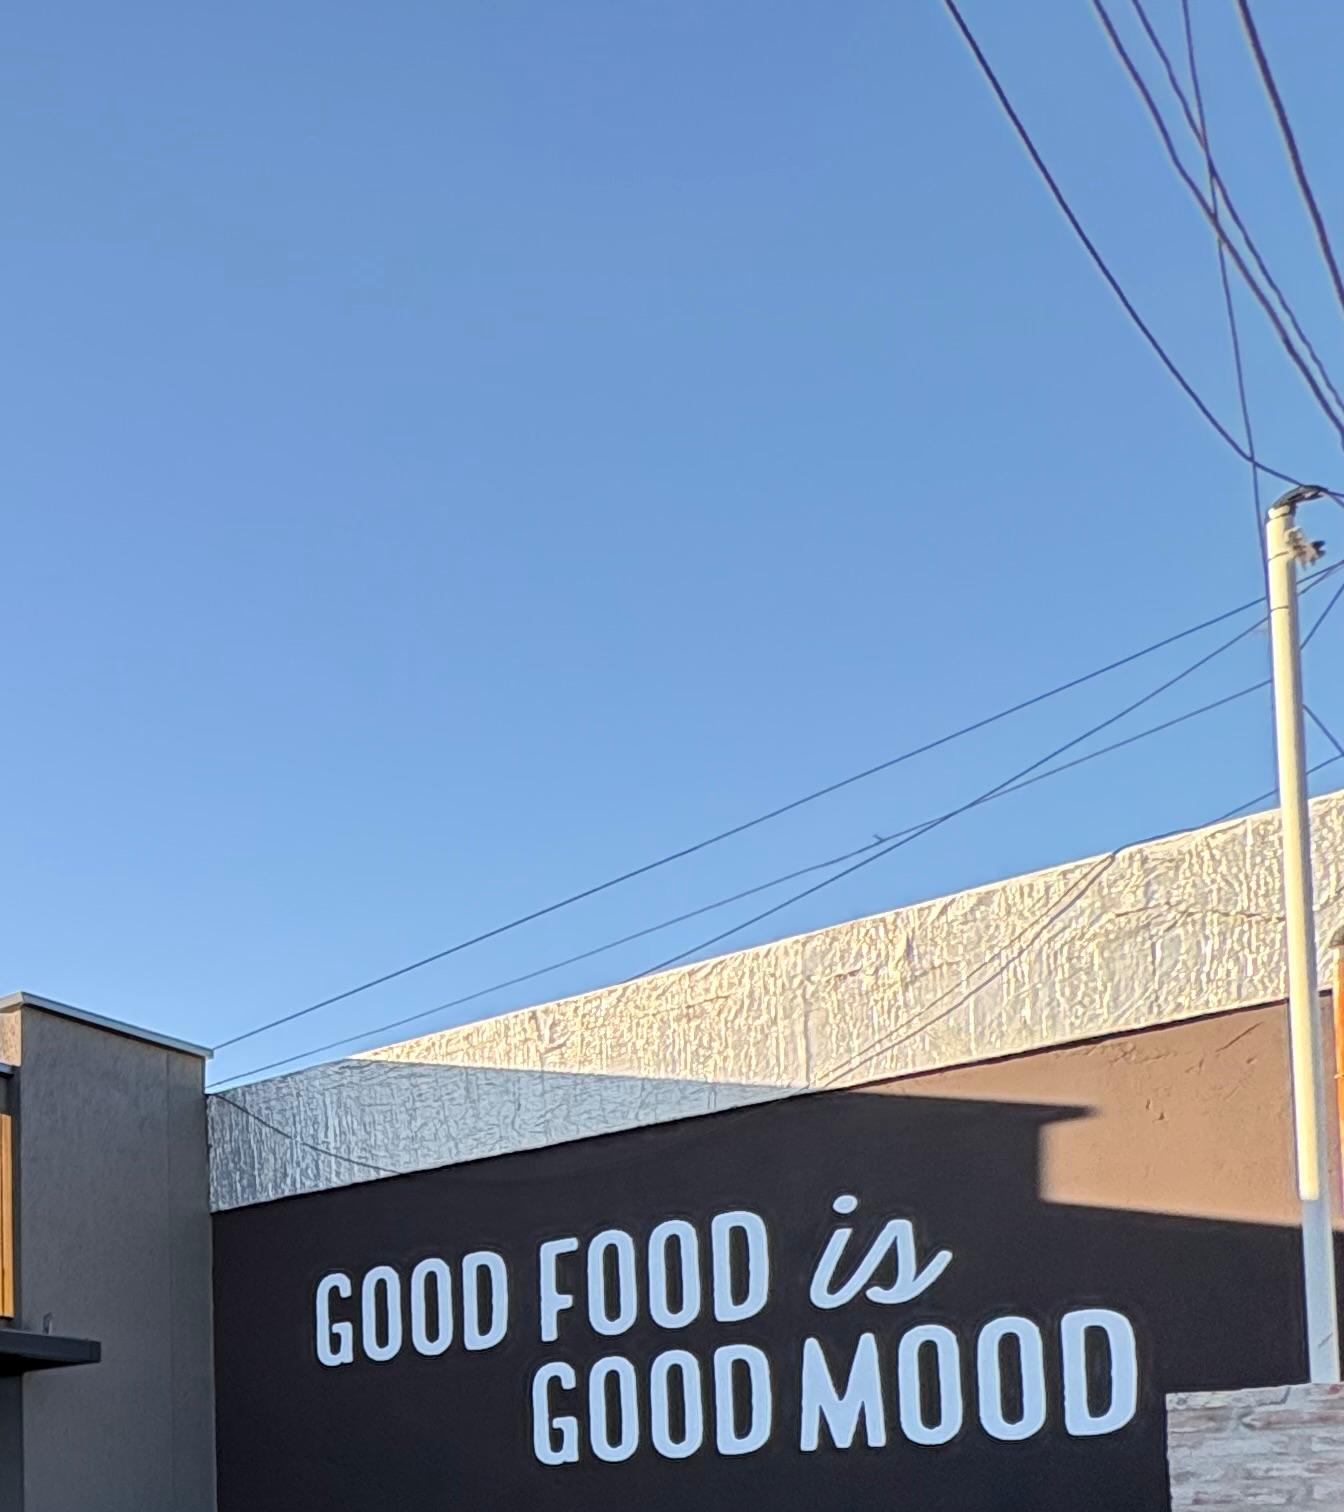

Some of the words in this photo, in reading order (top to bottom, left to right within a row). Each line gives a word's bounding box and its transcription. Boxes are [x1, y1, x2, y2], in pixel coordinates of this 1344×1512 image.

[314, 1249, 509, 1367] GOOD
[539, 1210, 771, 1343] FOOD
[809, 1195, 954, 1310] is
[531, 1344, 772, 1466] GOOD
[799, 1308, 1139, 1452] MOOD
